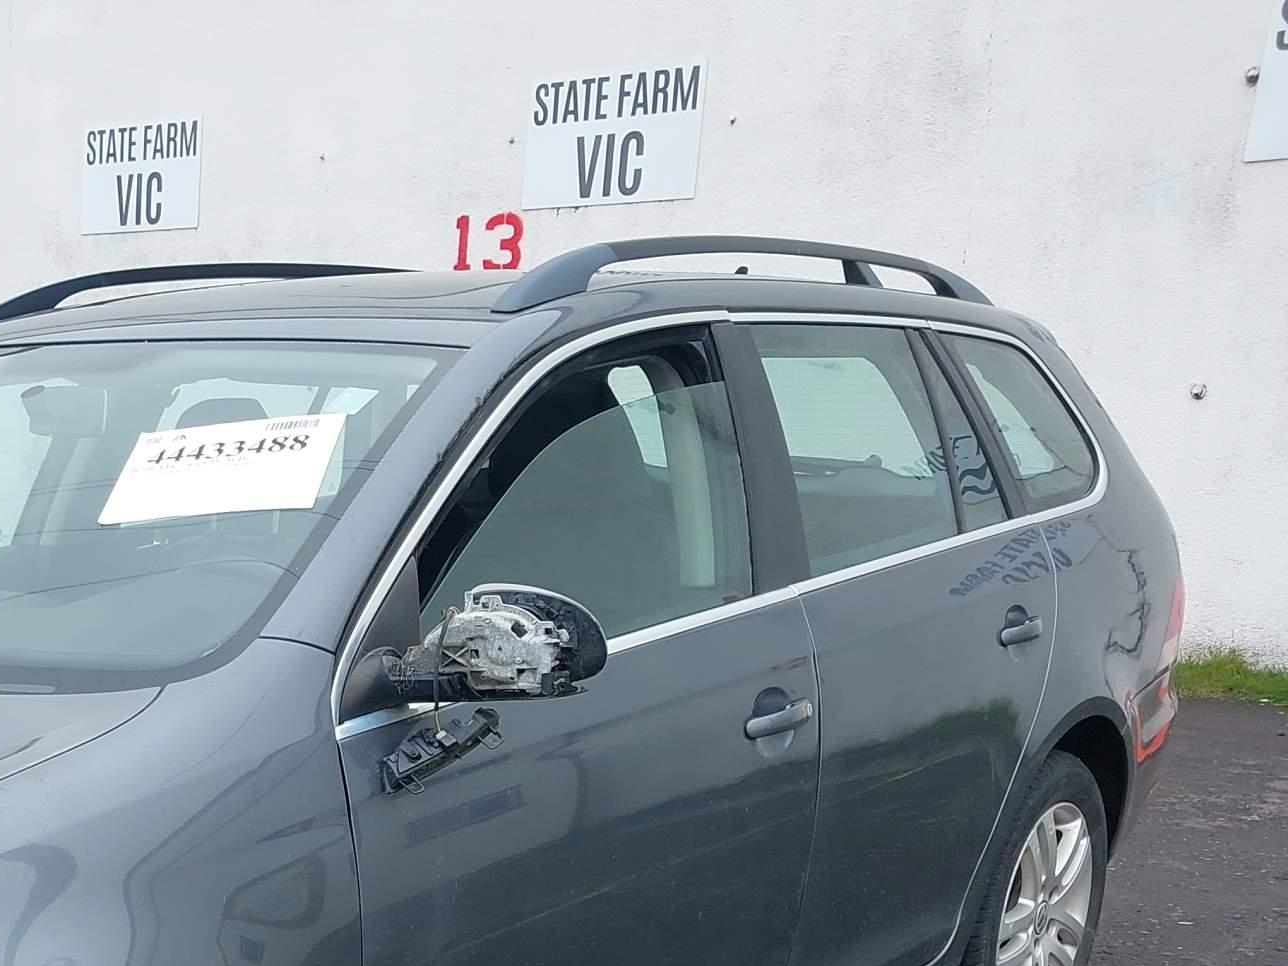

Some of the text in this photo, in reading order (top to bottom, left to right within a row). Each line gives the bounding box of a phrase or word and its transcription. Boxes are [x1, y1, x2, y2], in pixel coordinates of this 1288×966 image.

[533, 65, 700, 126] STATE FARM
[86, 120, 198, 166] STATE FARM
[576, 130, 644, 199] VIC
[116, 171, 163, 226] VIC
[453, 211, 524, 271] 13
[147, 434, 310, 464] 44433488
